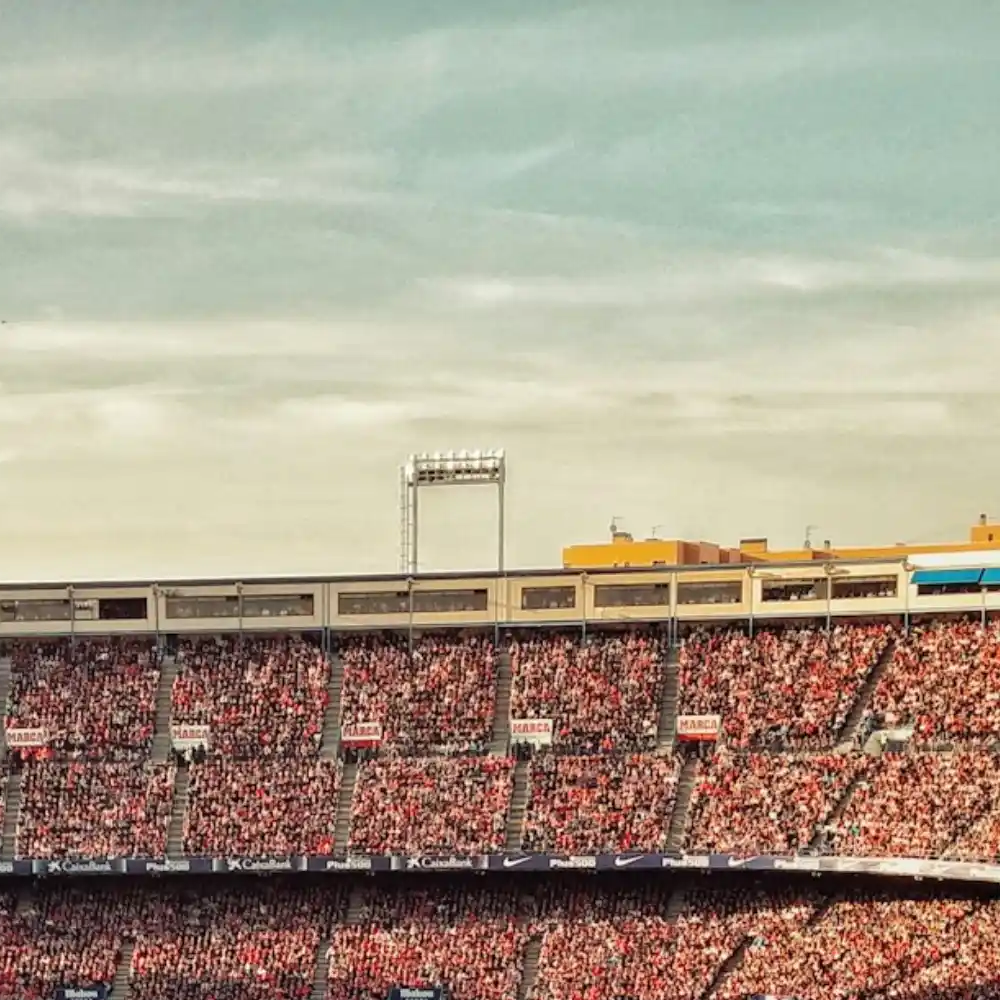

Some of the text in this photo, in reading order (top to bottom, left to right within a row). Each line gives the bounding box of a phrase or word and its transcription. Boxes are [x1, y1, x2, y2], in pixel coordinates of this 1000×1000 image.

[513, 723, 550, 734] MARCA
[680, 719, 717, 729] MARCA
[173, 729, 208, 739] MARCA
[344, 726, 380, 736] MARCA
[8, 731, 44, 742] MARCA
[242, 858, 292, 870] CaixaBank
